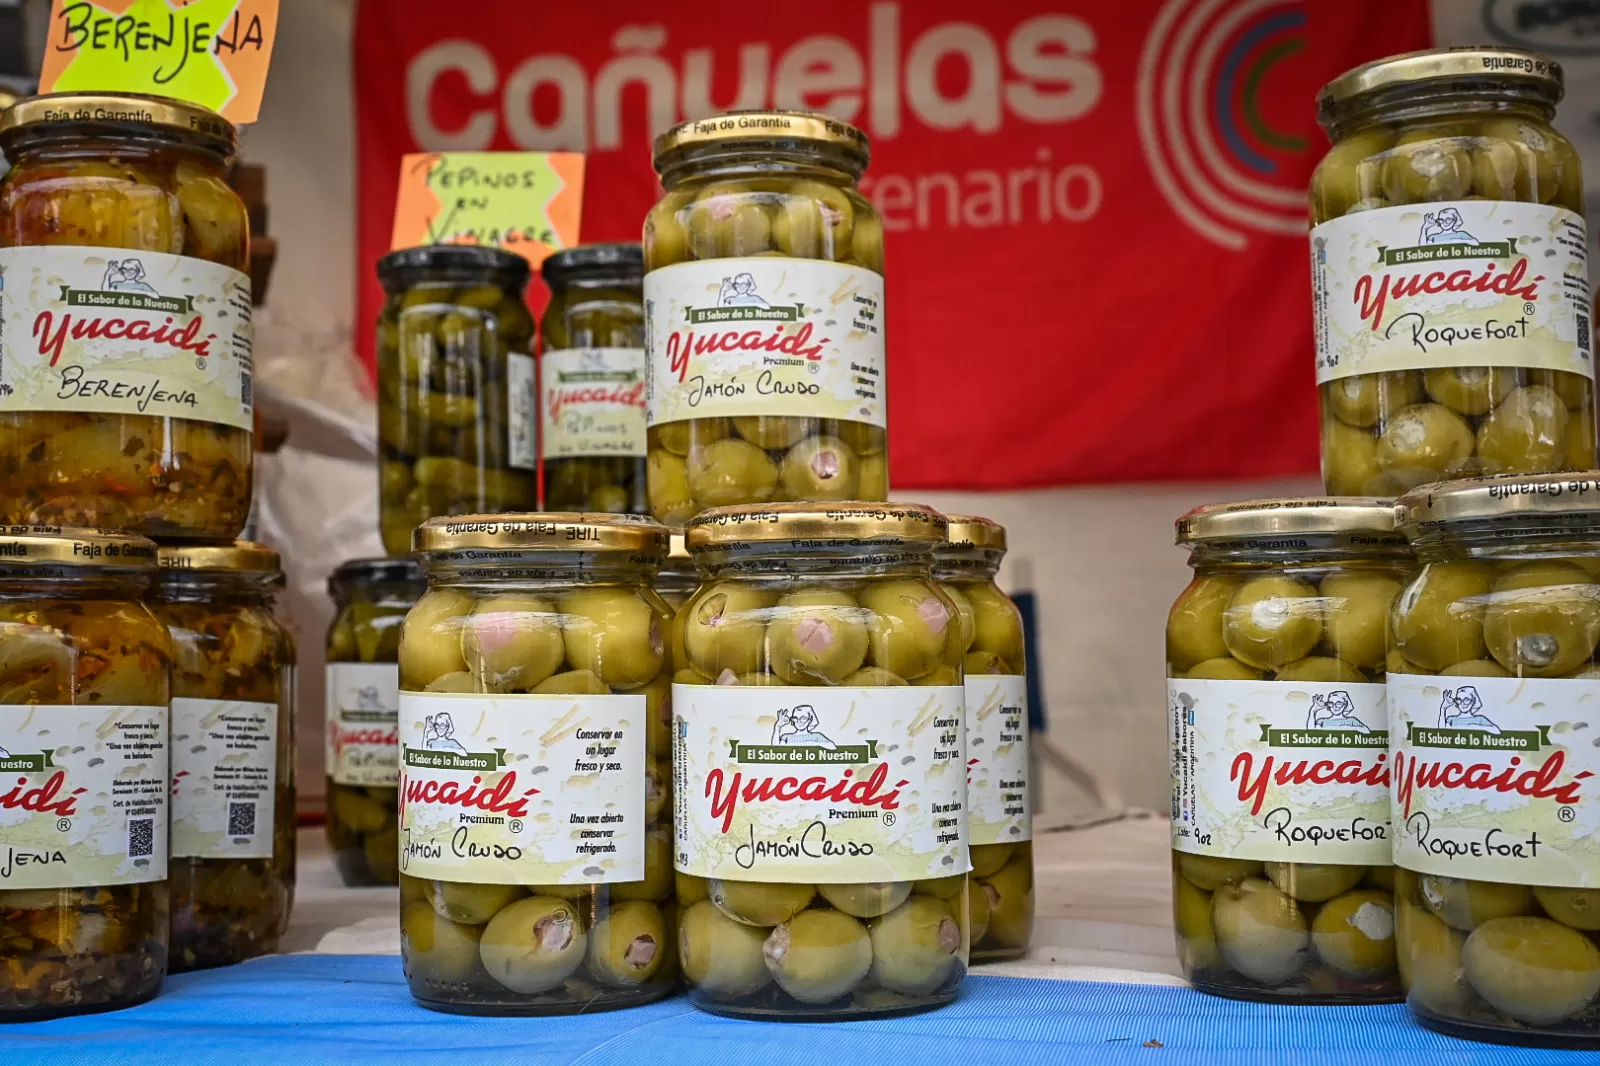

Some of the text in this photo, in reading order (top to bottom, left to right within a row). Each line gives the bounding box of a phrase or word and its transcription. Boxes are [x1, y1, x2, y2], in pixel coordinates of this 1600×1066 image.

[56, 1, 263, 84] BERENJENA
[1482, 57, 1533, 73] Garantía
[405, 3, 1103, 152] Cañuelas
[44, 108, 153, 123] Faja de Garantía
[694, 117, 791, 135] Faja de Garantía
[410, 152, 536, 189] PEPINOS
[860, 146, 1103, 232] enario
[456, 197, 489, 210] EN
[1396, 247, 1500, 262] El Sabor de lo Nuestro
[1354, 257, 1546, 331] Yucaidí
[78, 294, 179, 311] El Sabor de lo Nuestro
[698, 310, 789, 320] El Sabor de lo Nuestro
[32, 310, 217, 368] Yucaidí
[666, 322, 832, 383] Yucaidí
[763, 357, 804, 367] Premium
[57, 365, 198, 412] BERENJENA
[688, 375, 745, 407] JAMÓN
[1488, 481, 1590, 500] de Garantía
[731, 512, 747, 524] de
[750, 511, 779, 523] Faja
[890, 510, 904, 521] de
[908, 510, 928, 522] Faja
[446, 522, 600, 540] TIRE Faja de Garantía
[791, 538, 904, 550] Faja de Garantía
[947, 539, 975, 550] antía
[1247, 538, 1307, 549] Garantía
[0, 542, 119, 559] ntía Faja de
[466, 550, 522, 559] Garantía
[160, 556, 193, 569] TIRE
[576, 728, 623, 740] Conservar en
[1281, 733, 1290, 744] El
[1293, 733, 1322, 744] Sabor
[1325, 733, 1338, 744] de
[1341, 733, 1351, 744] lo
[1419, 734, 1528, 747] El Sabor de lo Nuestro
[585, 744, 616, 757] un lugar
[747, 749, 859, 761] El Sabor de lo Nuestro
[0, 760, 33, 769] uestro
[409, 752, 487, 767] El Sabor de lo Nuestro
[575, 759, 597, 772] fresco
[606, 761, 622, 771] seco.
[1231, 752, 1390, 816] Yucai
[1394, 750, 1595, 820] Yucaidí
[398, 769, 541, 830] Yucaidí
[705, 762, 910, 834] Yucaidí
[459, 813, 505, 825] Premium
[570, 813, 624, 824] Una vez abierto
[828, 809, 878, 820] Premium
[1264, 807, 1391, 846] ROQUEFOR
[580, 829, 614, 839] conservar
[575, 842, 617, 855] refrigerado.
